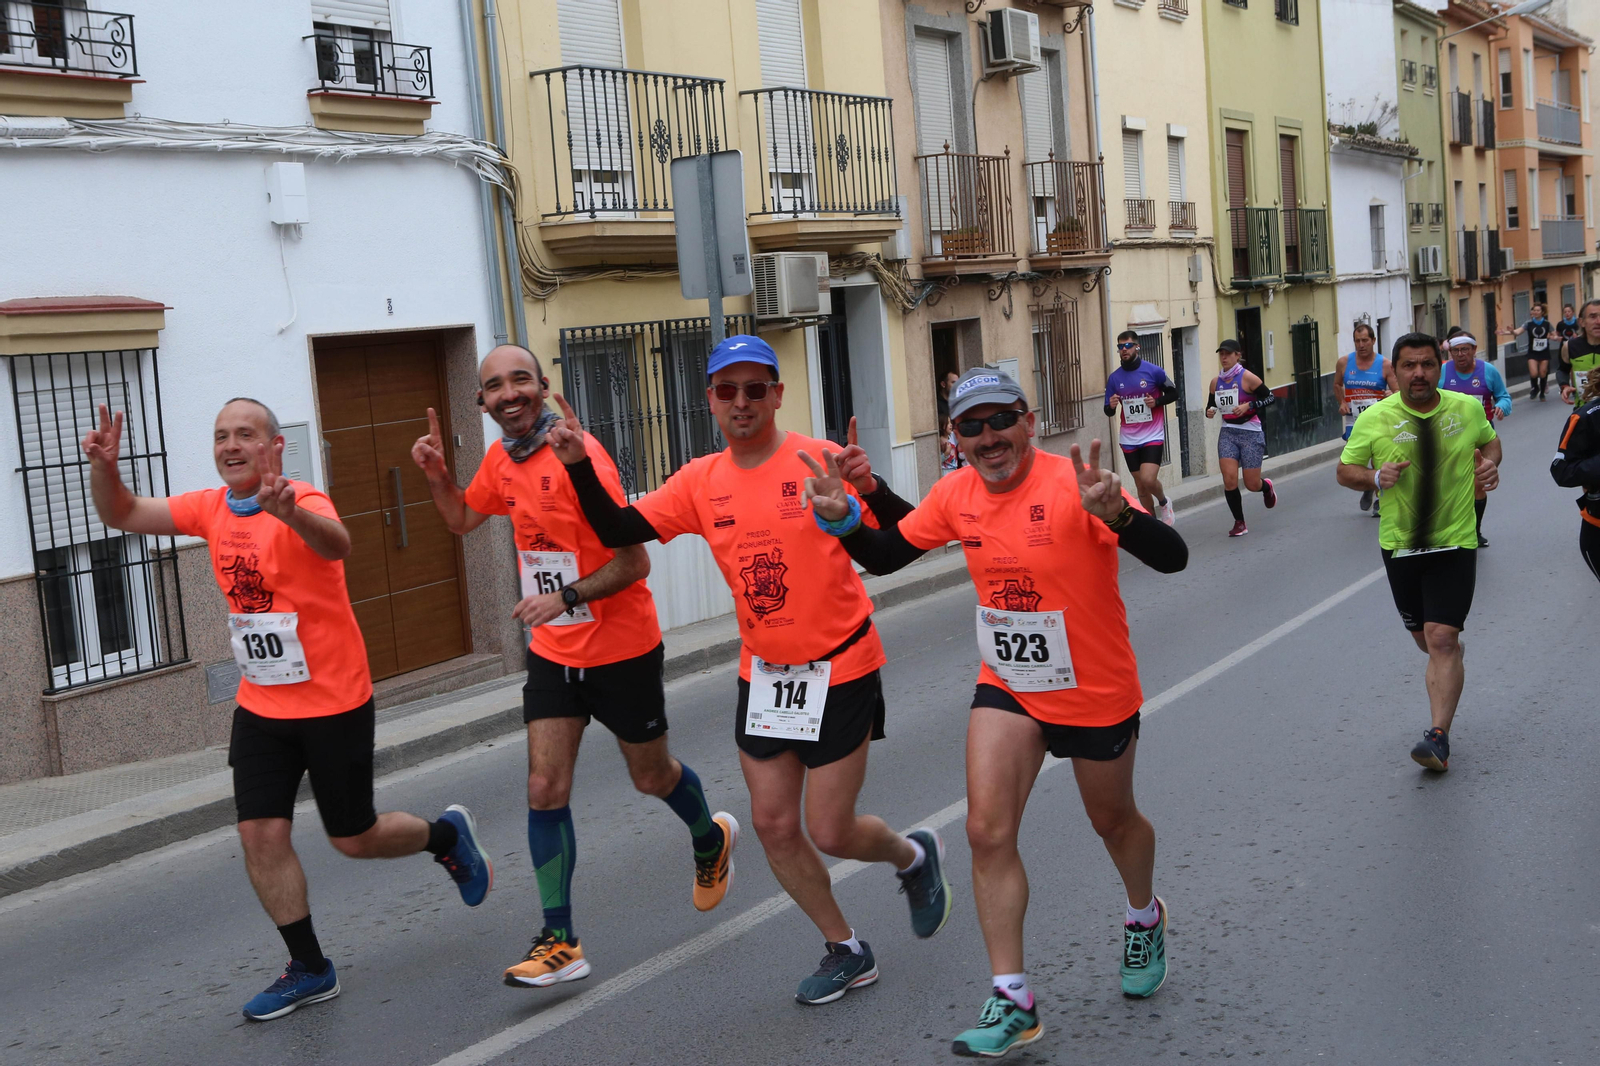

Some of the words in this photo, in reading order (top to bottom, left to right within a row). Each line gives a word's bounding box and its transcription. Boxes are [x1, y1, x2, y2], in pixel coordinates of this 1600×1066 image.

[1129, 404, 1145, 415] 847
[1220, 396, 1233, 405] 570
[533, 571, 563, 595] 151
[242, 632, 284, 660] 130
[993, 631, 1049, 663] 523
[773, 681, 807, 709] 114
